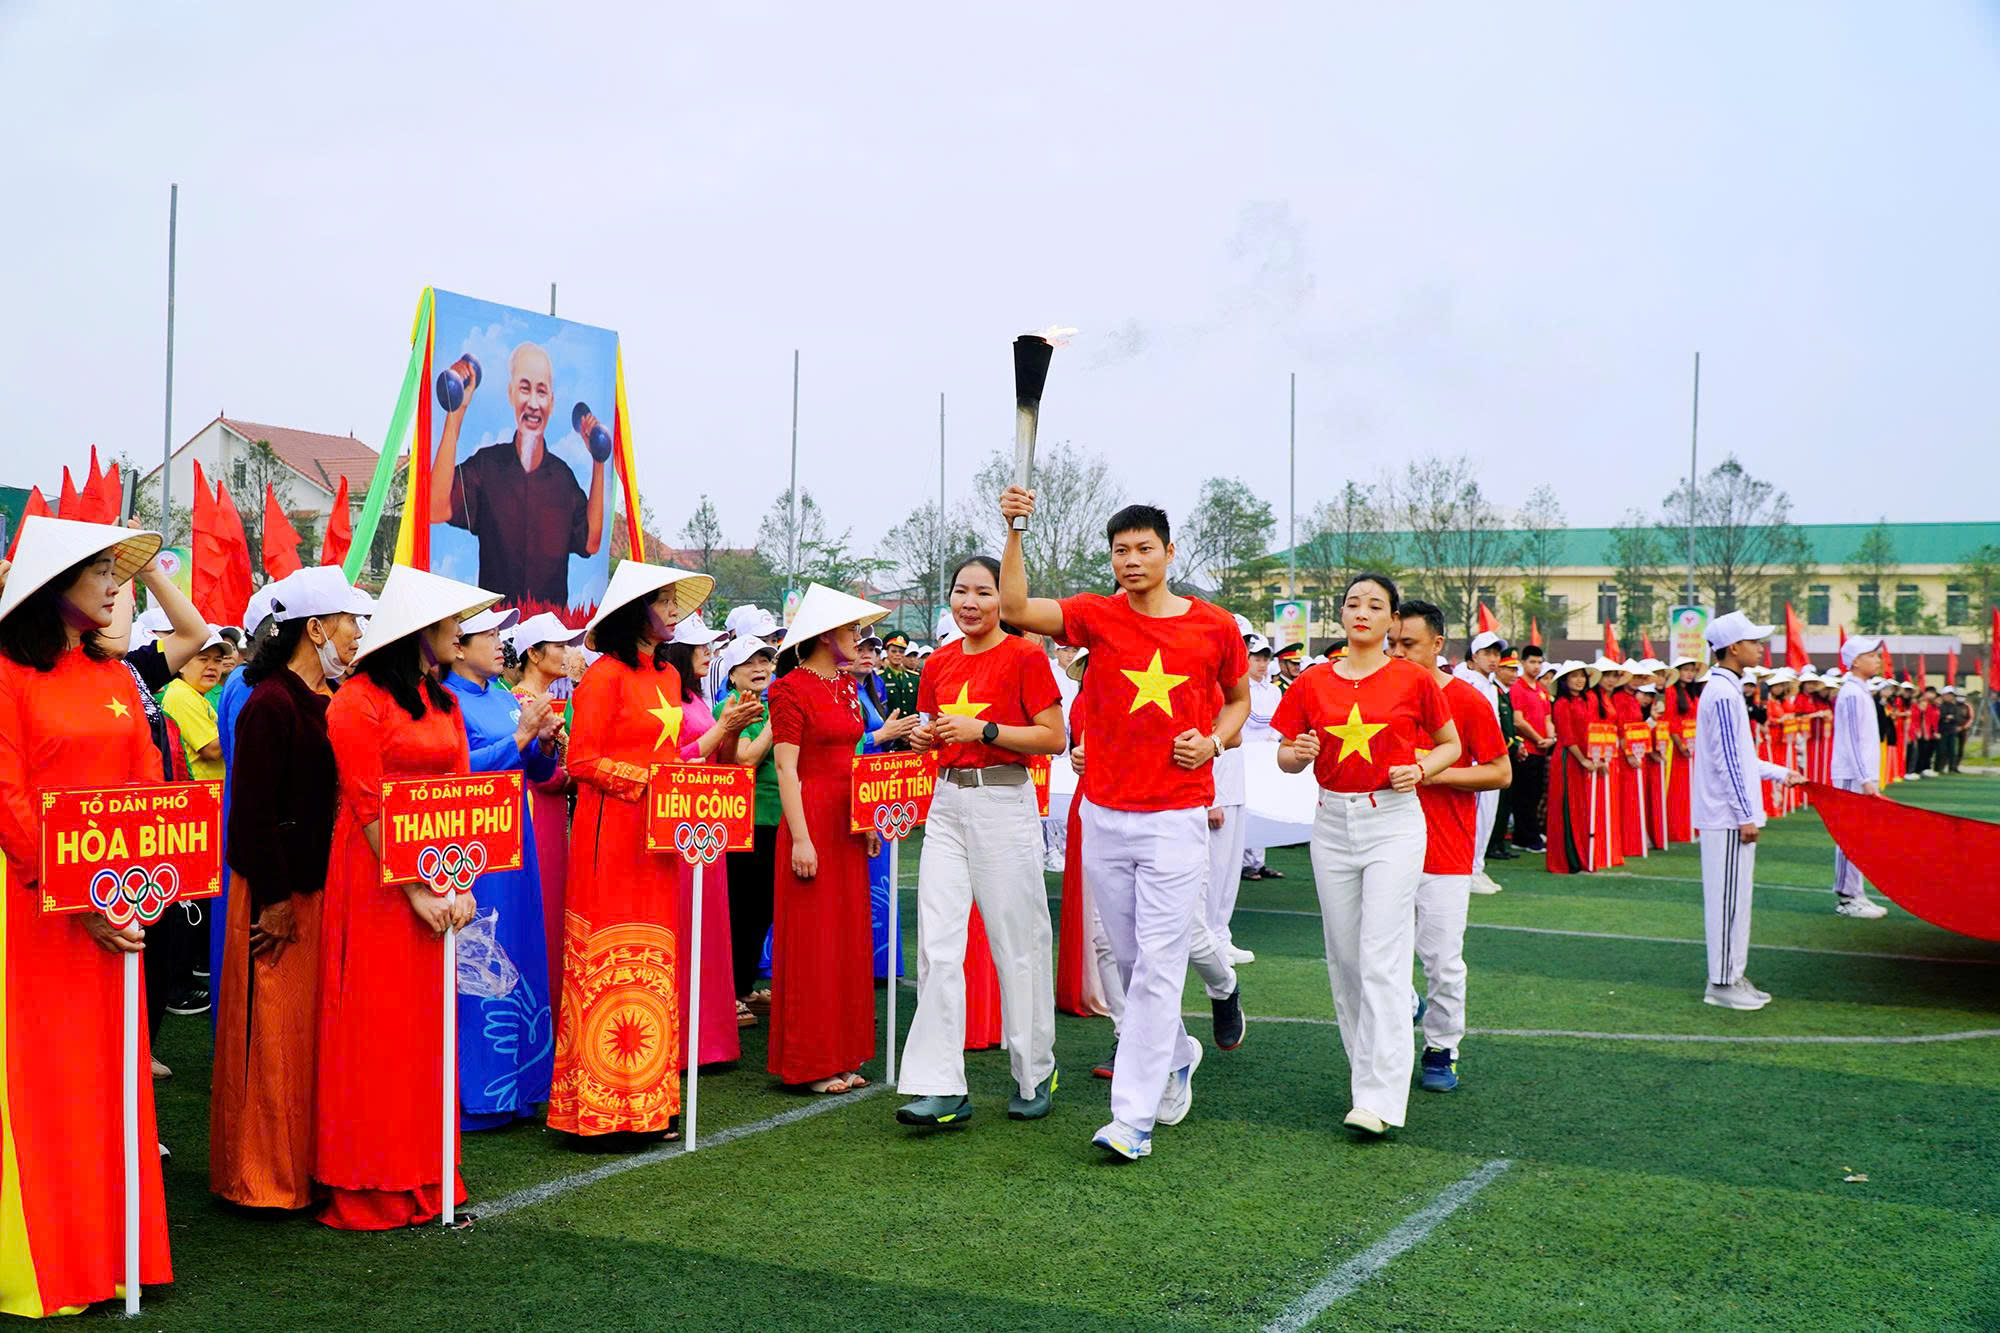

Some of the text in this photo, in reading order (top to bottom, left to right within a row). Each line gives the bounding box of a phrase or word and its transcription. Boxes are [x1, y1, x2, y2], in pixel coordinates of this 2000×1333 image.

[671, 767, 735, 785] TỔ DÂN PHỐ
[870, 755, 923, 772] TỔ DÂN PHỐ
[409, 779, 495, 801] TỔ DÂN PHỐ
[859, 768, 933, 804] QUYẾT TIẾN
[80, 789, 189, 815] TỔ DÂN PHỐ
[657, 787, 747, 819] LIÊN CÔNG
[392, 797, 513, 843] THANH PHÚ
[57, 814, 208, 865] HÒA BÌNH
